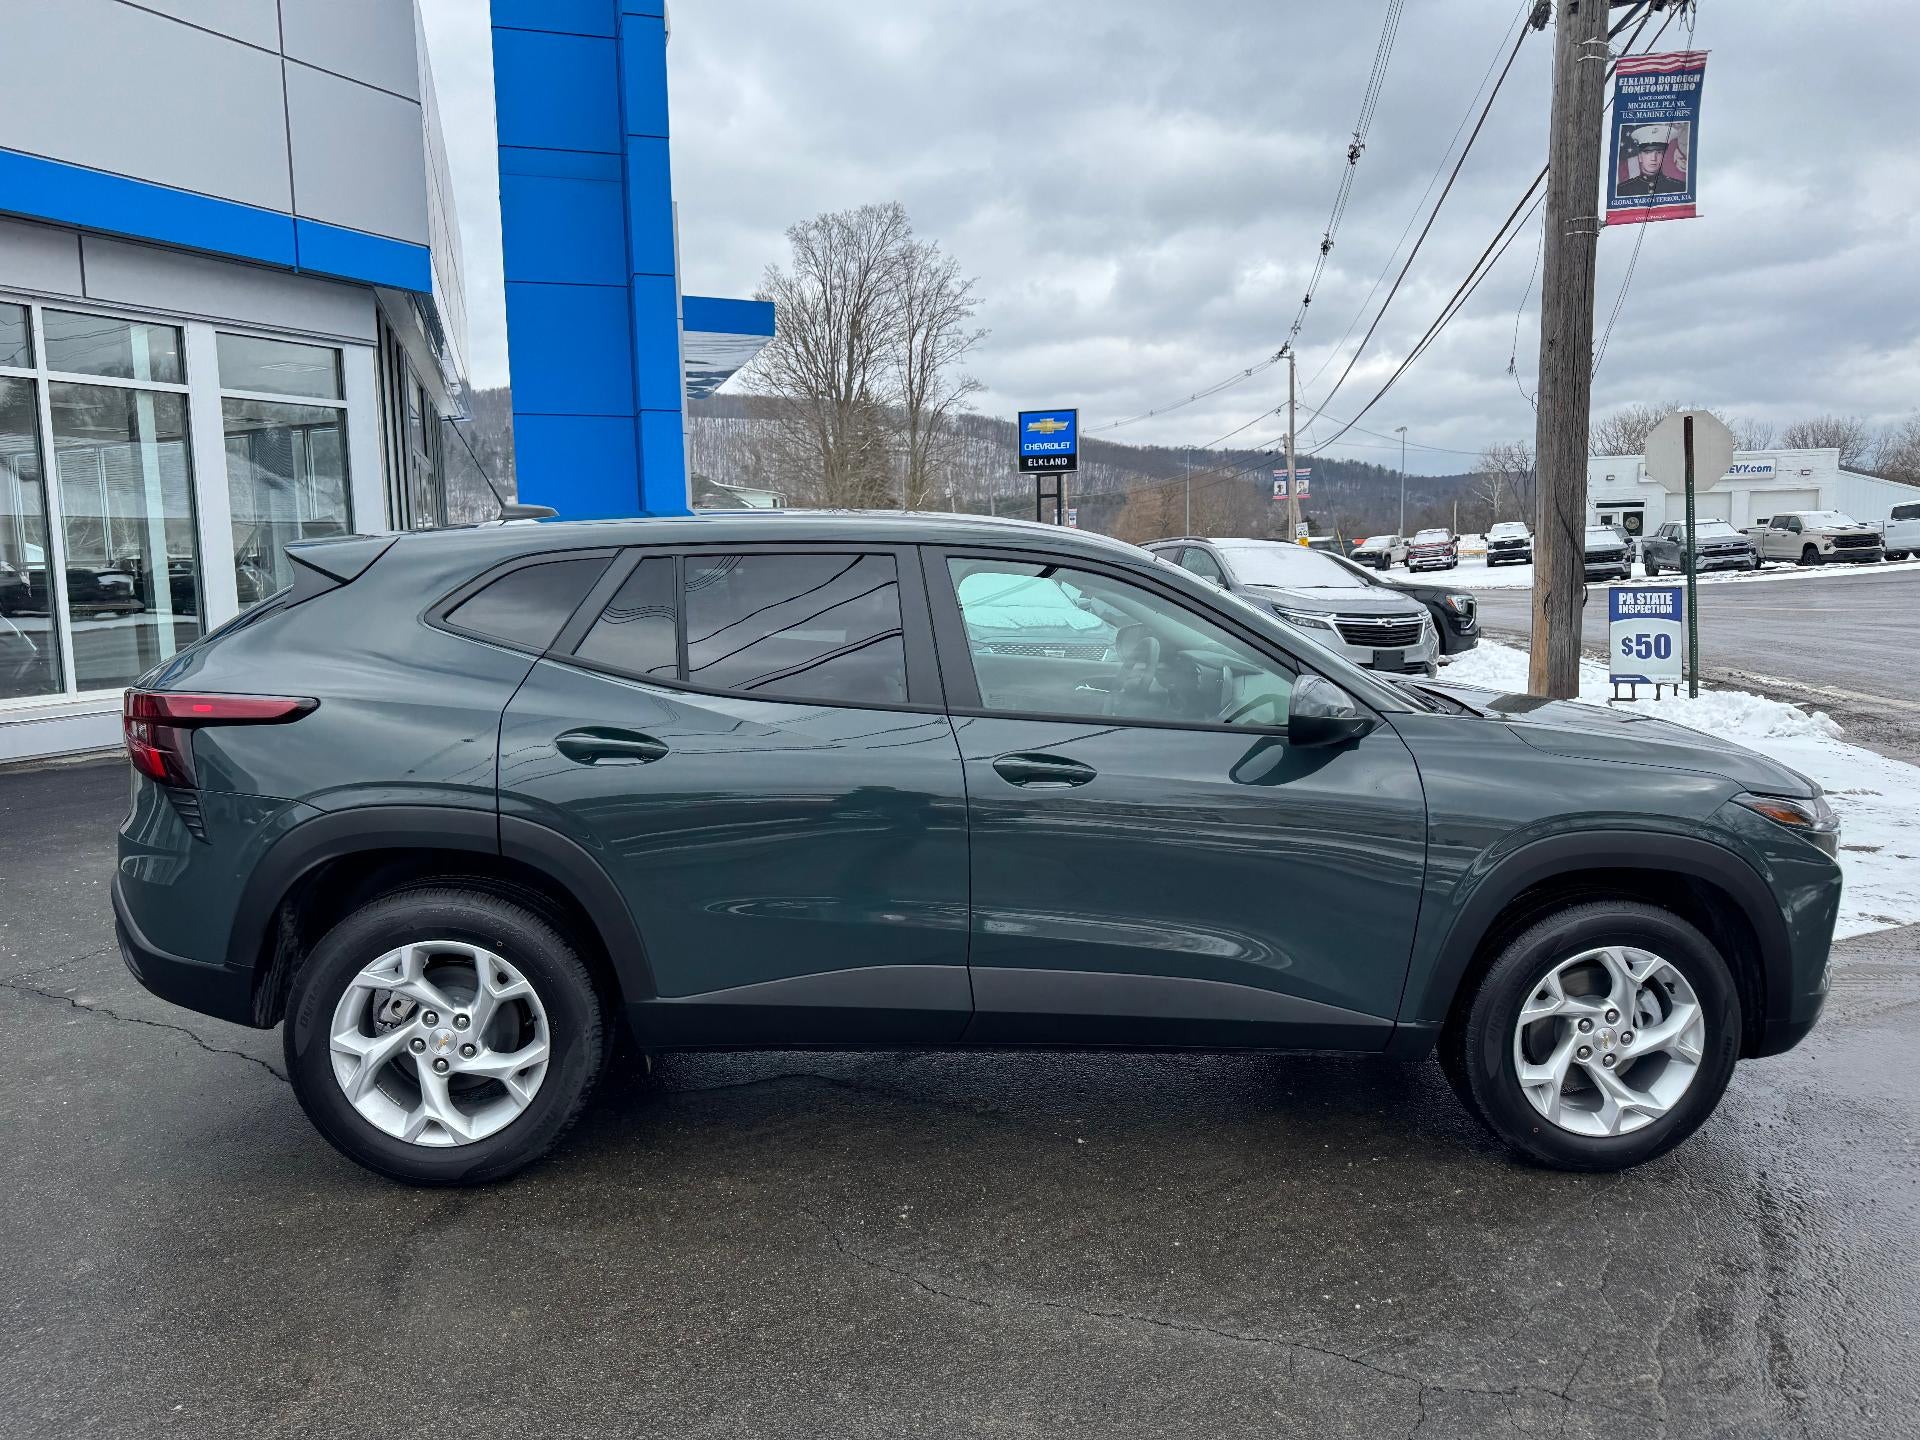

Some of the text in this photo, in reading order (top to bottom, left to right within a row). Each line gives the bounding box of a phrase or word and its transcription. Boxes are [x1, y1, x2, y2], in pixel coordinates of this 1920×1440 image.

[1619, 74, 1701, 85] ELKLAND BOROUGH
[1621, 83, 1696, 94] HOMETOWN HERO
[1622, 109, 1691, 119] U.S. MARINE CORPS
[1024, 442, 1071, 451] CHEVROLET
[1028, 458, 1068, 467] ELKLAND
[1726, 465, 1772, 473] EVY.com
[1618, 593, 1672, 604] PA STATE
[1619, 605, 1672, 613] INSPECTION
[1621, 632, 1672, 660] $50
